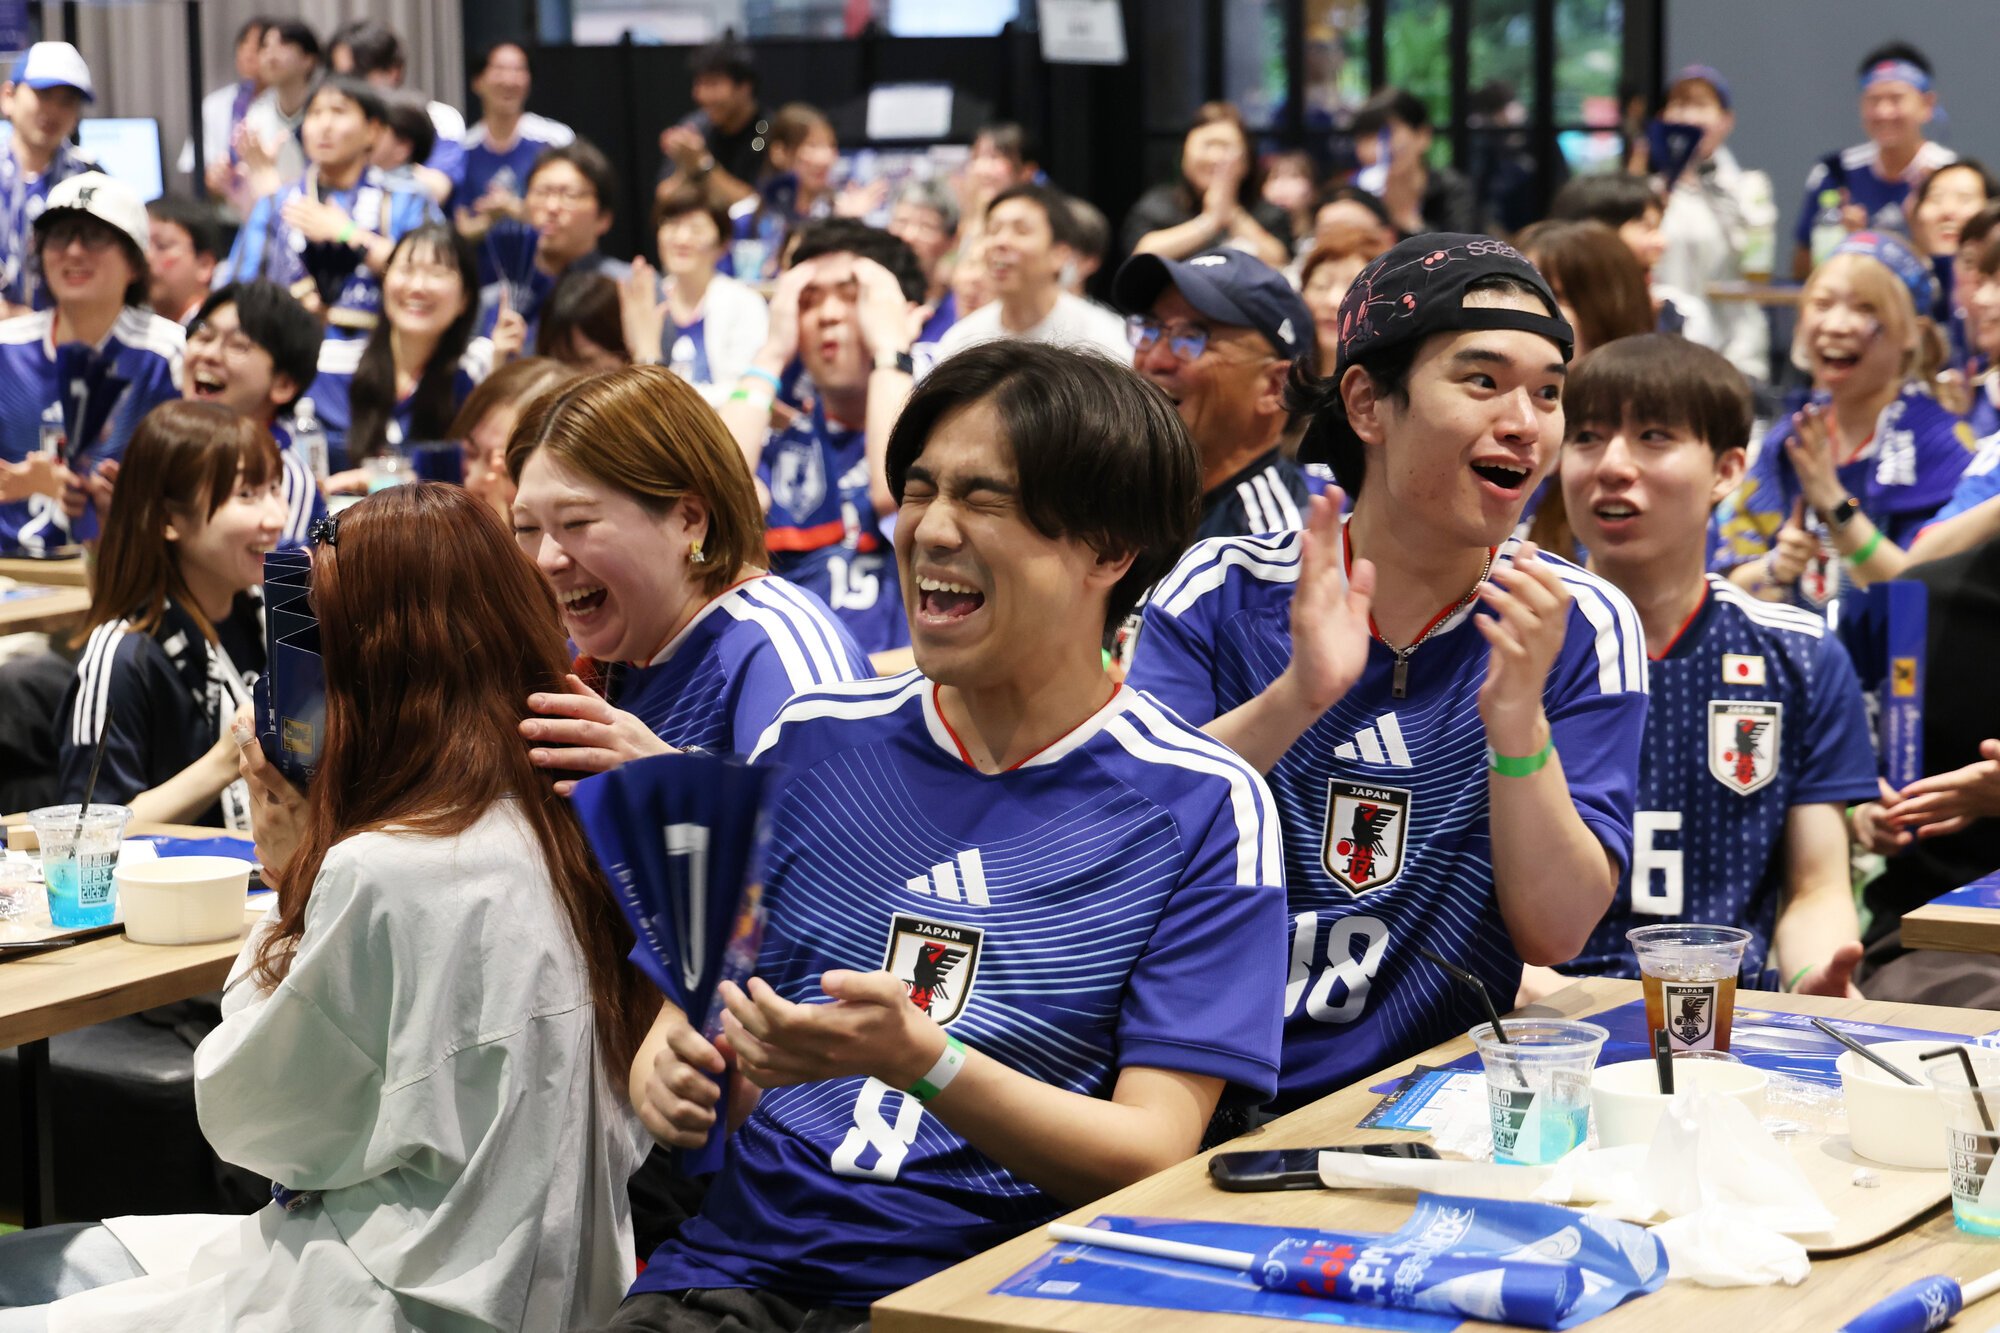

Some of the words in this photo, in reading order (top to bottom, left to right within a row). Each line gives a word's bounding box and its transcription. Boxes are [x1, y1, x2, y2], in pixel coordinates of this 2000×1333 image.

[1350, 786, 1391, 801] JAPAN
[1341, 858, 1377, 879] JFA
[1631, 811, 1683, 916] 6
[81, 885, 101, 900] 2026
[915, 923, 961, 940] JAPAN
[1679, 1026, 1700, 1036] JFA
